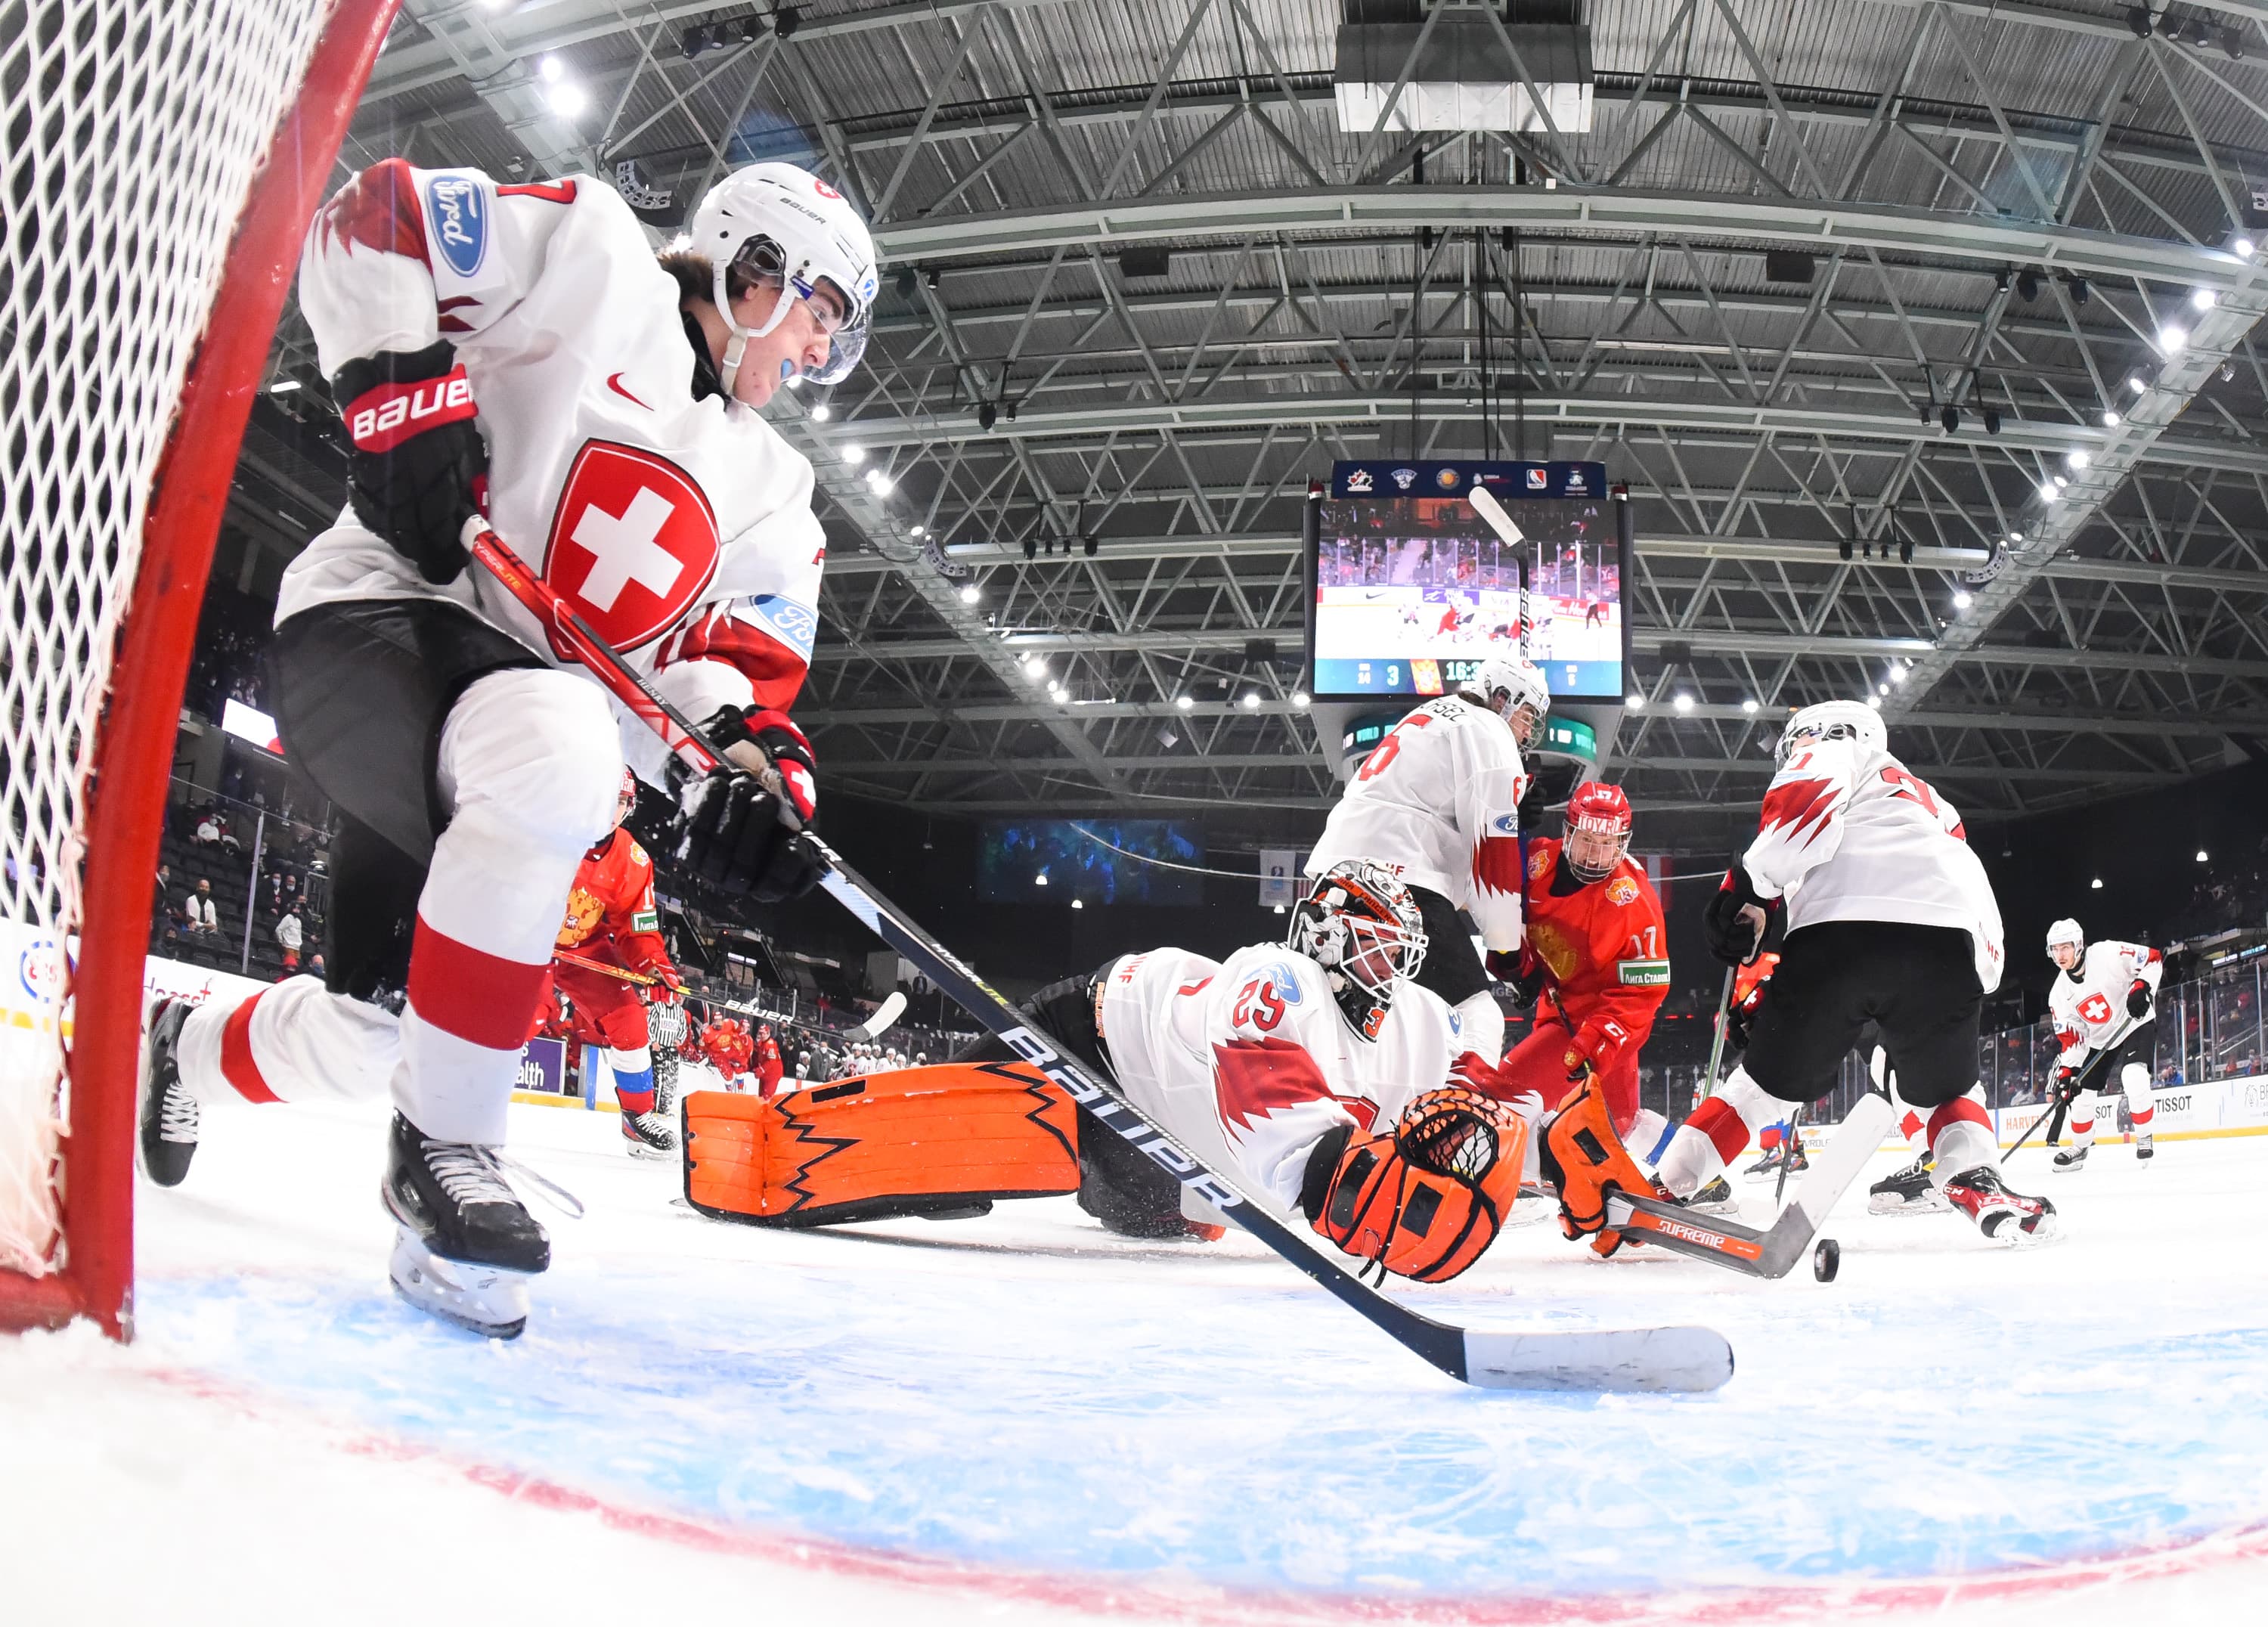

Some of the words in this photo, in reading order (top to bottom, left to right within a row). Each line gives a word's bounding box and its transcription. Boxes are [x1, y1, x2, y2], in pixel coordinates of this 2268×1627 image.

[432, 180, 478, 246] Ford
[779, 197, 826, 225] BAUER
[352, 377, 475, 441] BAUE
[475, 540, 522, 590] YPERLITE
[1387, 665, 1399, 686] 3
[637, 678, 669, 705] HENRY
[1596, 789, 1613, 800] 17
[1631, 925, 1657, 959] 17
[931, 944, 1009, 1006] HYPERLITE
[725, 999, 794, 1025] BAUER
[516, 1060, 544, 1087] alth
[998, 1025, 1244, 1211] BAUER
[2095, 1105, 2112, 1119] SOT
[2155, 1096, 2192, 1113] TISSOT
[1944, 1185, 1965, 1196] CM
[1982, 1195, 2042, 1210] CCM
[1656, 1219, 1724, 1249] SUPREME
